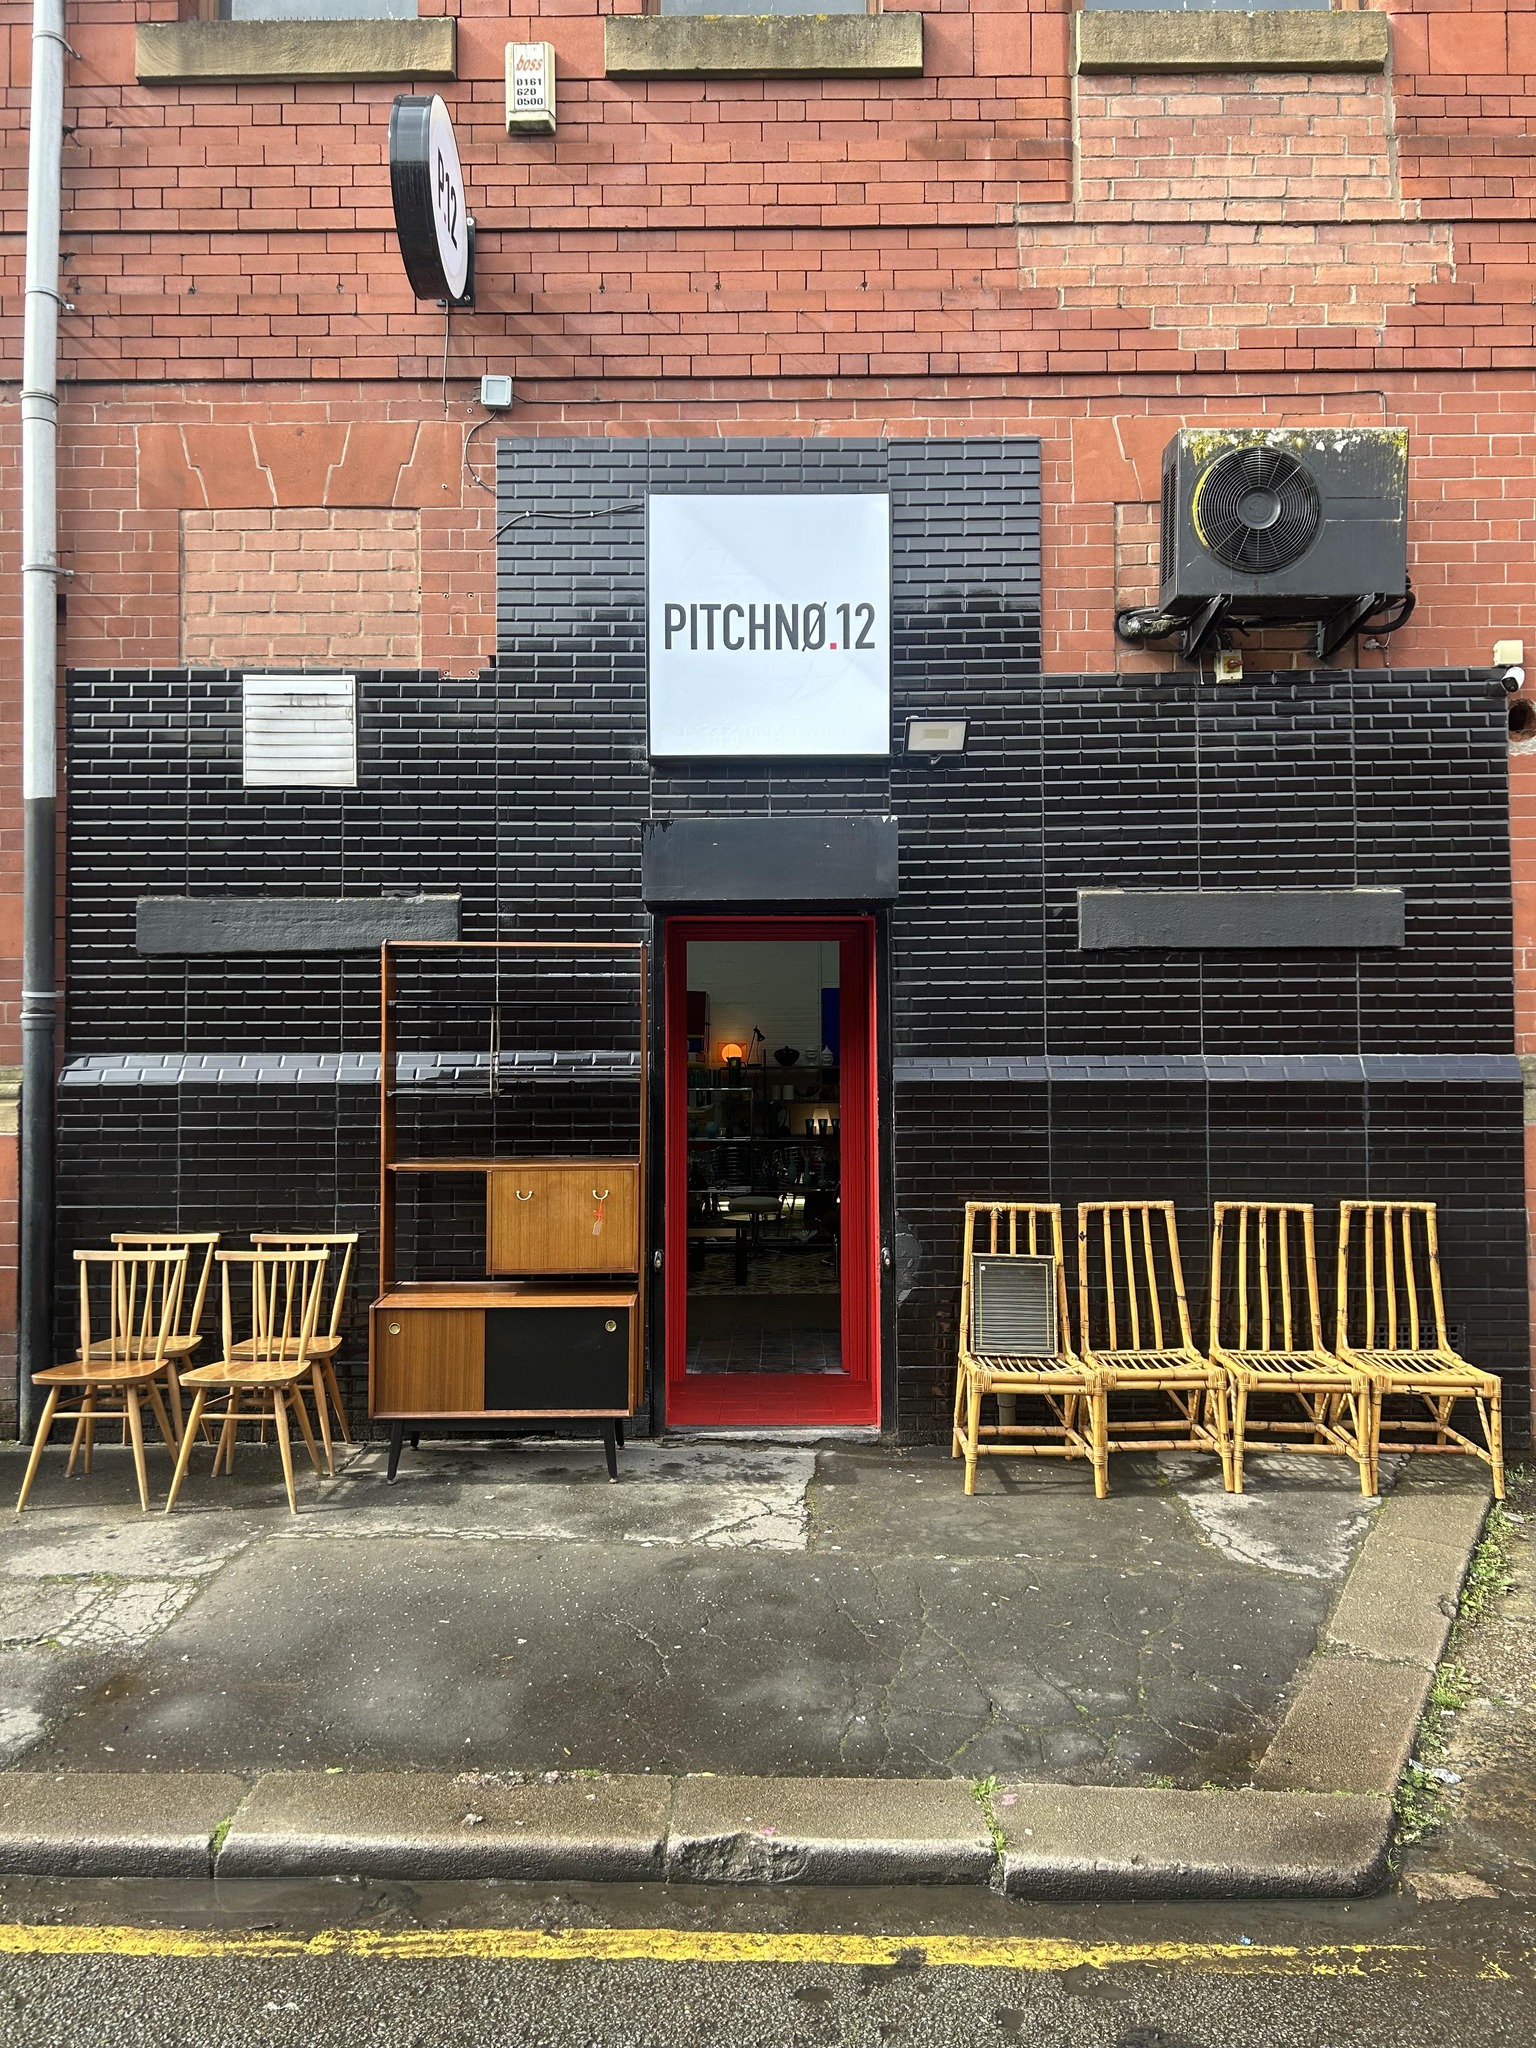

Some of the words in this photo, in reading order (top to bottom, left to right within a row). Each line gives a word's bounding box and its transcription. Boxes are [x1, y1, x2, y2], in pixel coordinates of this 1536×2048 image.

[516, 55, 543, 71] boss
[516, 78, 542, 86] 0161
[516, 87, 537, 96] 620
[516, 97, 544, 106] 0500
